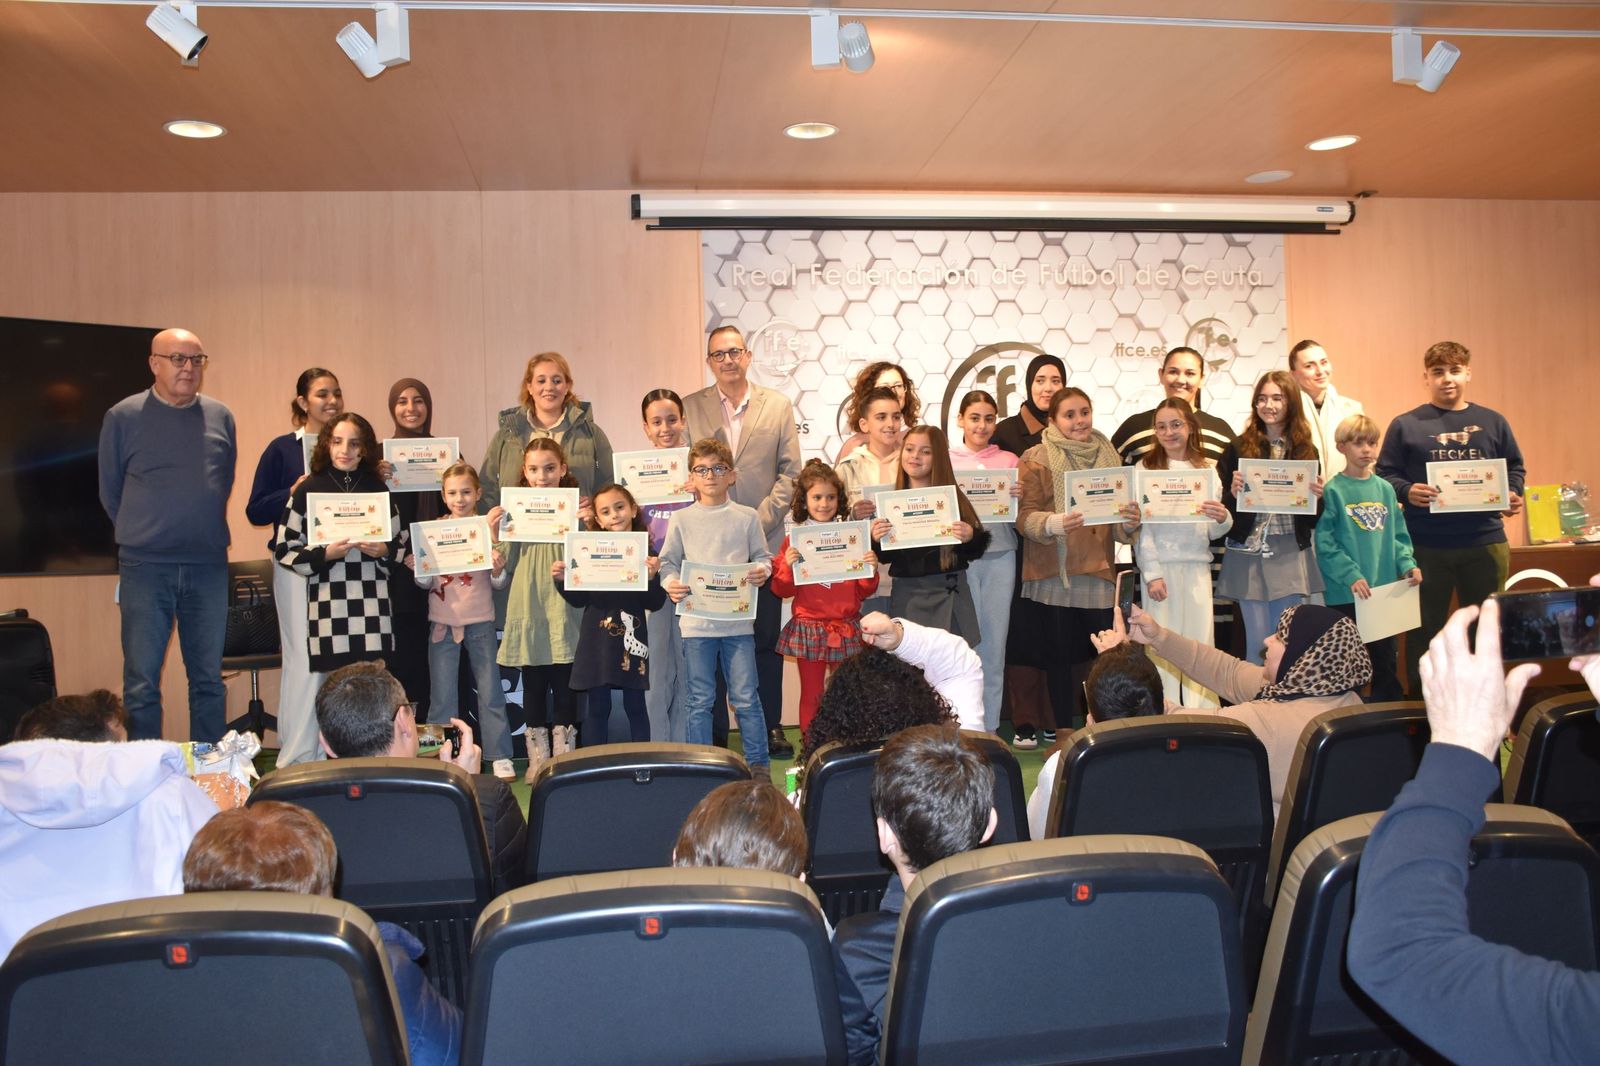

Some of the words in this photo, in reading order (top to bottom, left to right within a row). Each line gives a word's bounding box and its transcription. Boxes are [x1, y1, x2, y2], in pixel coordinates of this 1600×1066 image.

[732, 263, 796, 286] Real
[810, 259, 979, 286] Federación
[991, 263, 1026, 286] de
[1135, 263, 1171, 286] de
[1181, 263, 1263, 286] Ceuta
[1429, 448, 1486, 461] TECKEL
